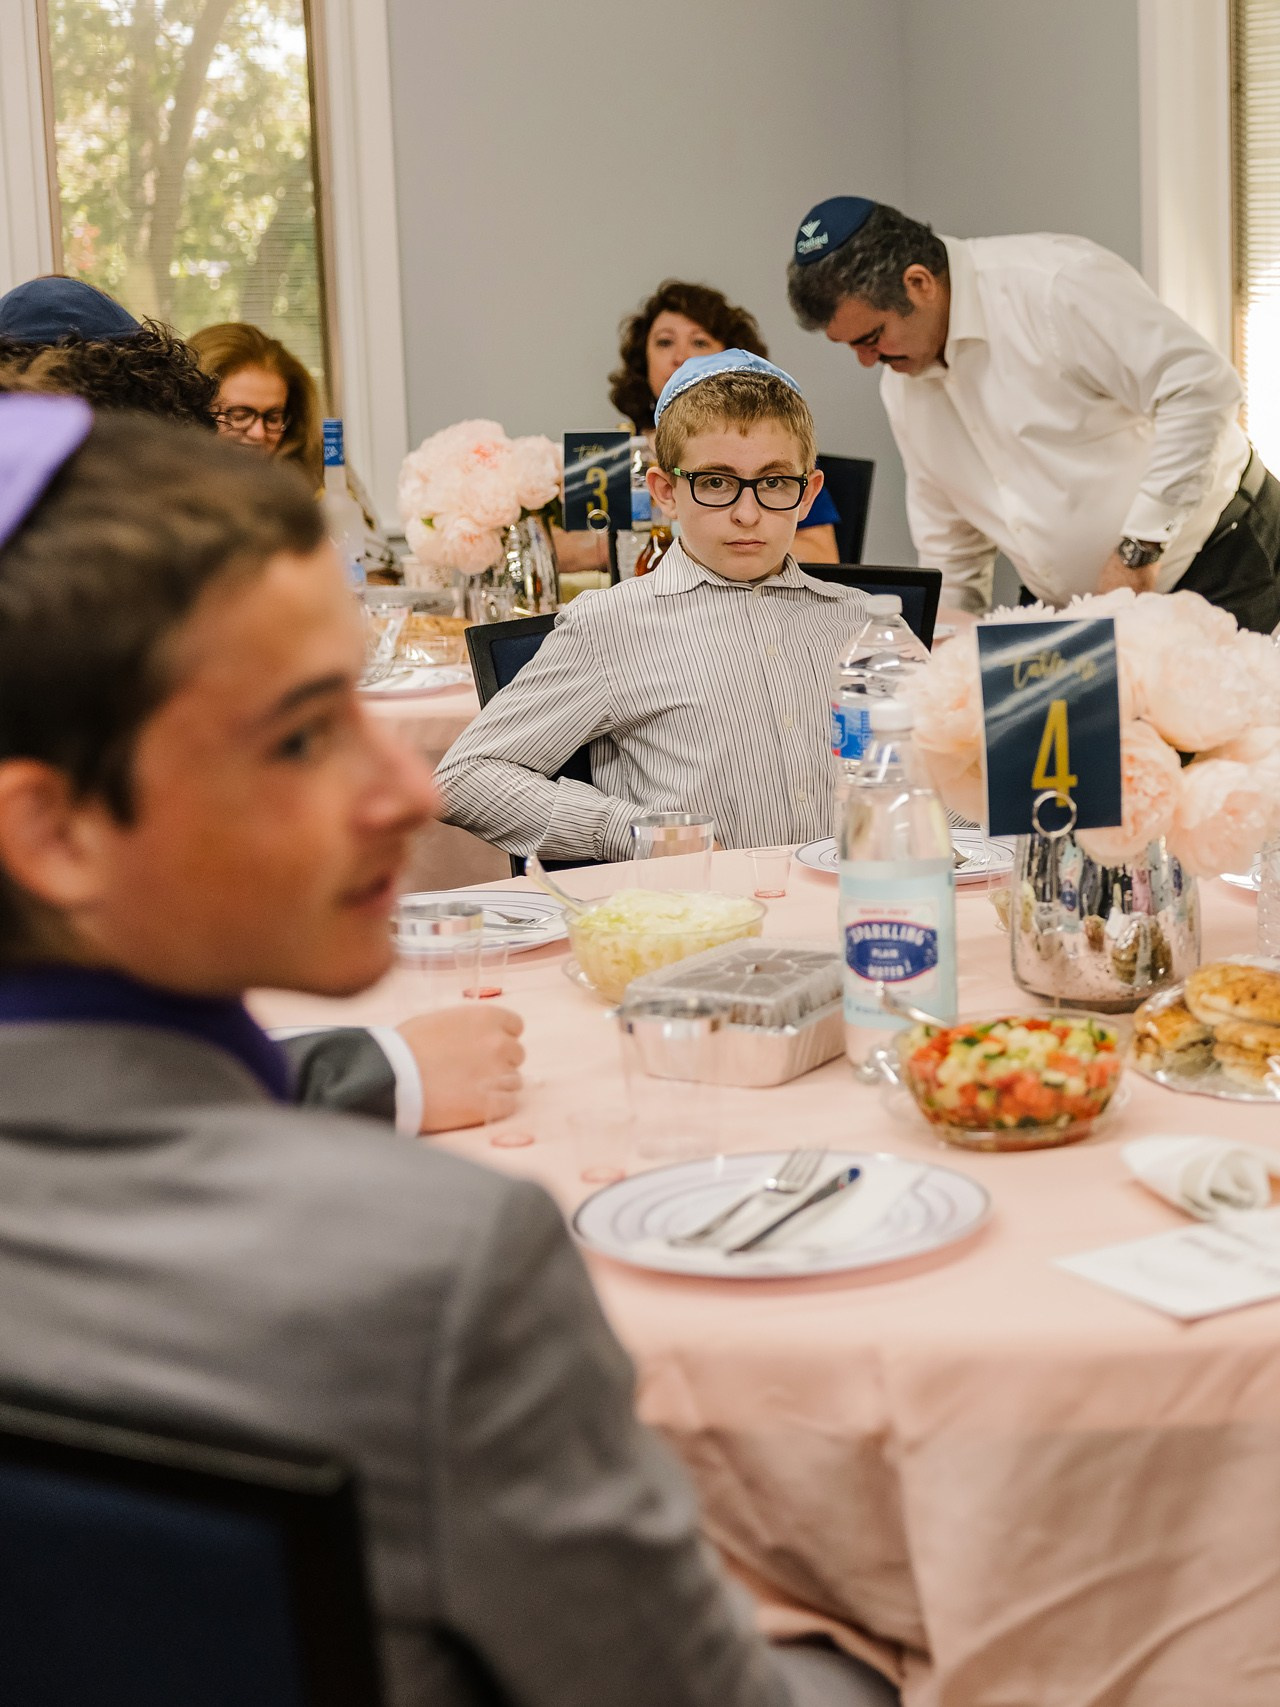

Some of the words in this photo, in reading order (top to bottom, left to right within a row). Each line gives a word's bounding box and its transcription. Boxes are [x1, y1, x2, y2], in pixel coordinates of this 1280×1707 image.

[585, 466, 608, 520] 3
[1032, 699, 1078, 807] 4
[849, 923, 924, 946] SPARKLING
